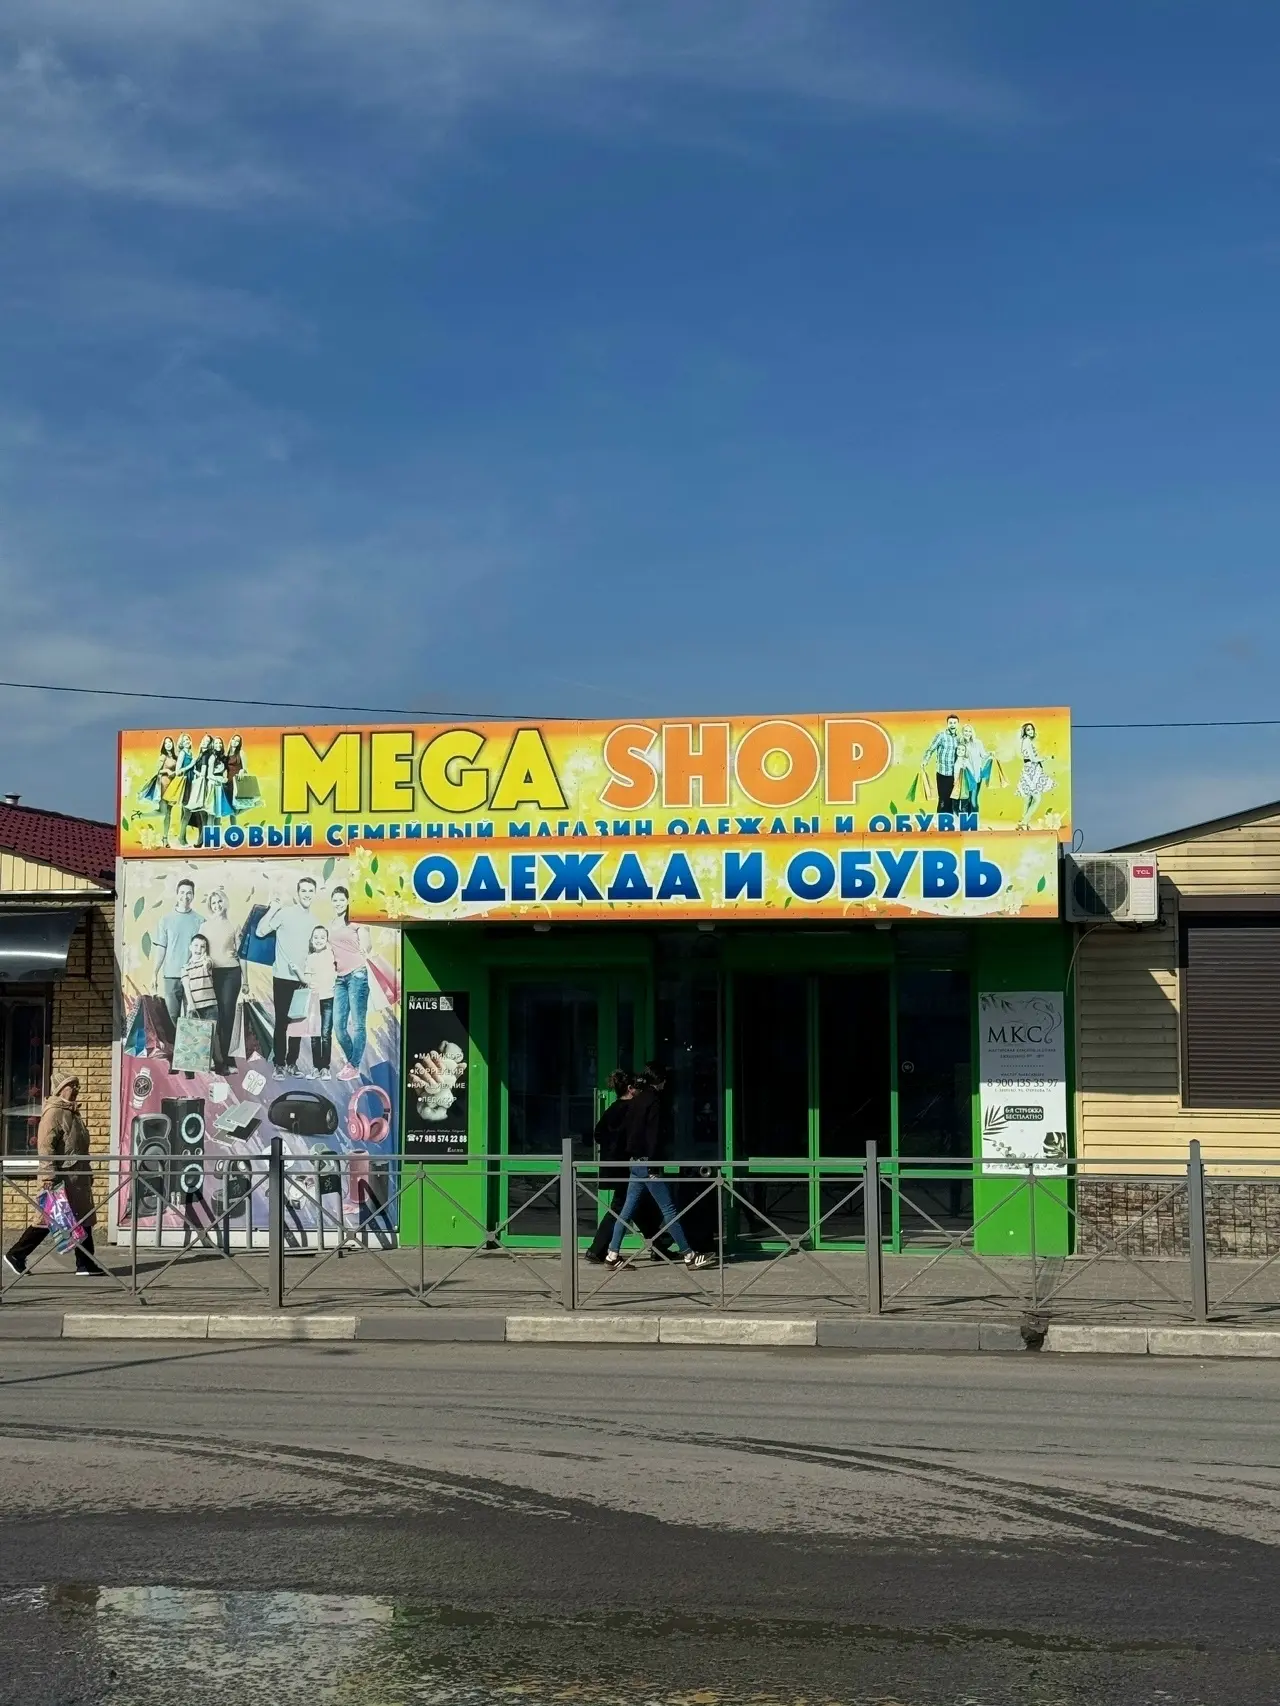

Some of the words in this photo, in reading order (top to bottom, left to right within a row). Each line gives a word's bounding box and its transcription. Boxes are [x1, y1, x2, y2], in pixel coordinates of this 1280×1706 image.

[280, 728, 569, 815] MEGA
[600, 720, 891, 810] SHOP
[203, 822, 314, 849] НОВЫЙ
[326, 820, 494, 846] СЕМЕЙНЫЙ
[508, 819, 653, 838] МАГАЗИН
[835, 815, 853, 833] И
[869, 812, 978, 833] ОБУВИ
[413, 852, 701, 905] ОДЕЖДА
[722, 850, 764, 901] И
[786, 848, 1003, 901] ОБУВЬ
[409, 1001, 438, 1010] NAILS
[414, 1067, 464, 1076] КОРРЕКЦИЯ
[987, 1078, 994, 1088] 8
[995, 1078, 1014, 1088] 900
[1017, 1078, 1031, 1088] 135
[1033, 1078, 1046, 1088] 35
[1047, 1078, 1058, 1088] 97
[437, 1134, 450, 1143] 574
[450, 1134, 459, 1143] 22
